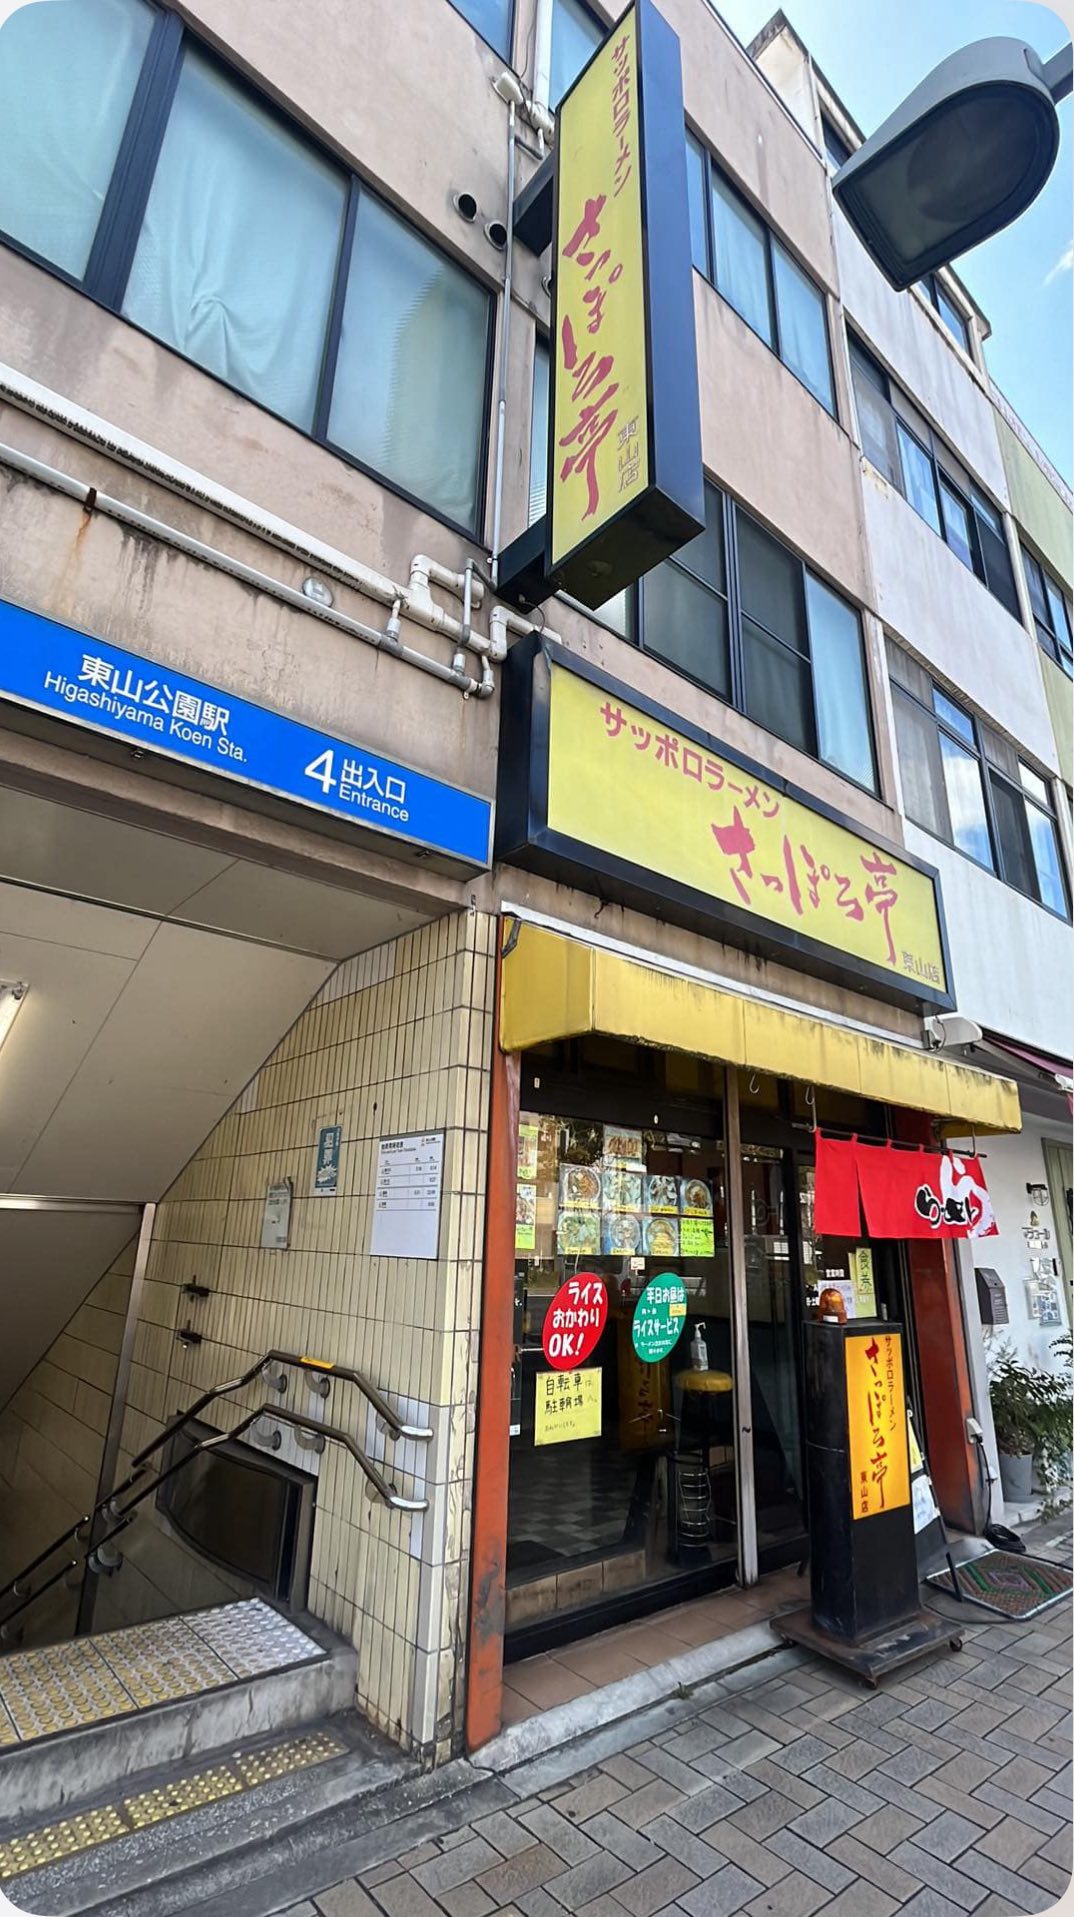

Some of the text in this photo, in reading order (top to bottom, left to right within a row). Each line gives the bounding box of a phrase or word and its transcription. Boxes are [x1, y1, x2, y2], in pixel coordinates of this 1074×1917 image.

[611, 34, 632, 197] サッポロラーメン
[617, 415, 641, 493] 東山店
[43, 670, 248, 764] Higashiyama Koen Sta.
[77, 653, 230, 736] 東山公園駅
[304, 748, 407, 804] 4 出入口
[600, 701, 780, 818] サッポロラーメン
[338, 782, 410, 822] Entrance
[711, 805, 899, 965] さっぽろ亭
[901, 950, 941, 985] 東山店
[552, 1307, 600, 1329] おかわり
[568, 1281, 603, 1305] ライス
[646, 1286, 685, 1305] 平日お昼は
[548, 1332, 585, 1358] OK!
[633, 1317, 680, 1339] ライスサービス
[884, 1335, 897, 1432] サッポロラーメン
[864, 1337, 888, 1509] さっぽろ亭
[859, 1470, 870, 1514] 東山店
